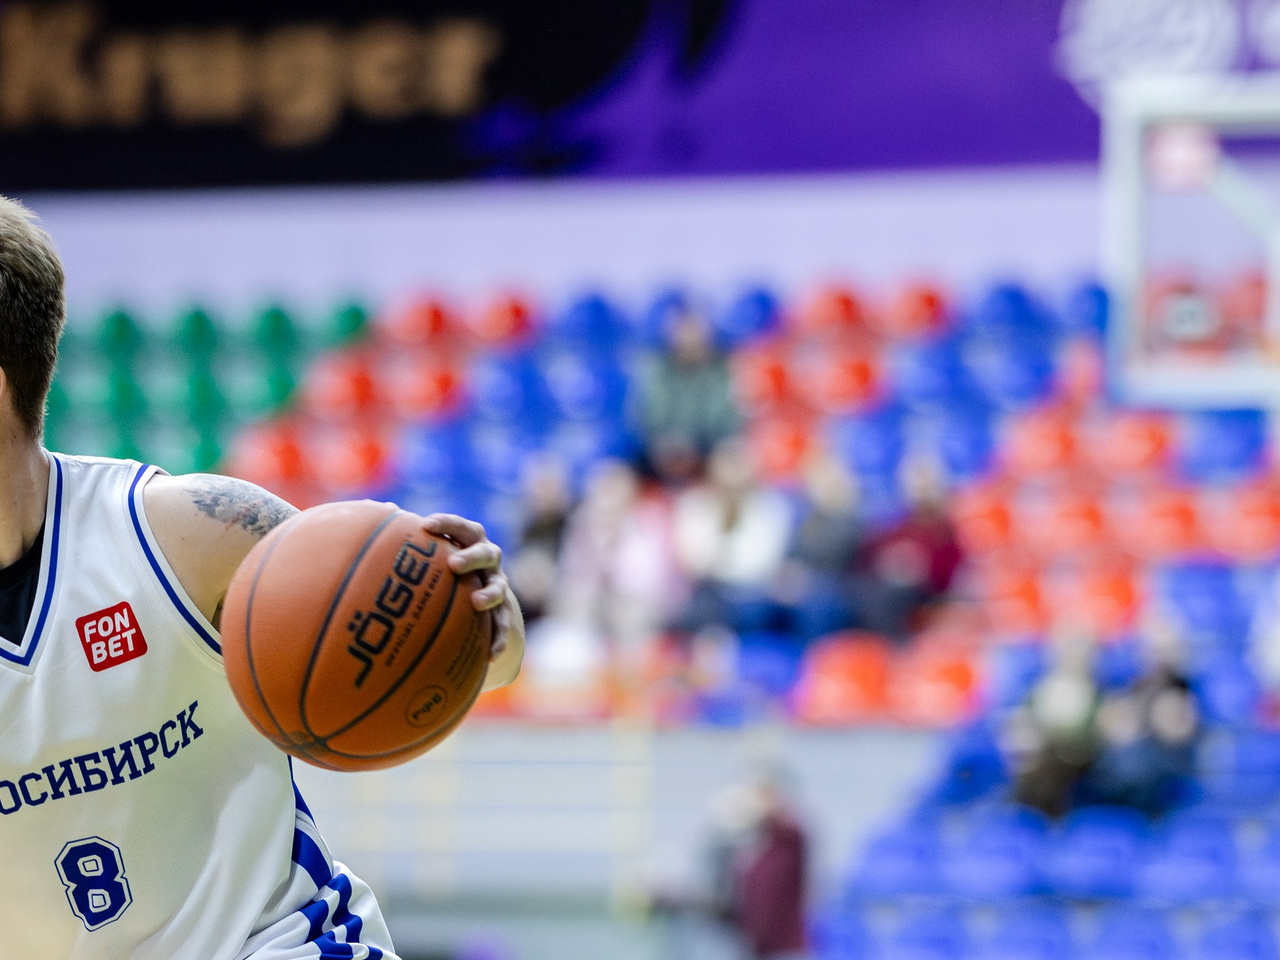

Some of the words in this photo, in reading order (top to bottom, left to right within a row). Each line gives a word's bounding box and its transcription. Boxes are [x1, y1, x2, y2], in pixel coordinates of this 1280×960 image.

[83, 607, 130, 643] FON
[91, 627, 137, 665] BET
[346, 541, 438, 689] JÖGEL
[54, 835, 133, 932] 8
